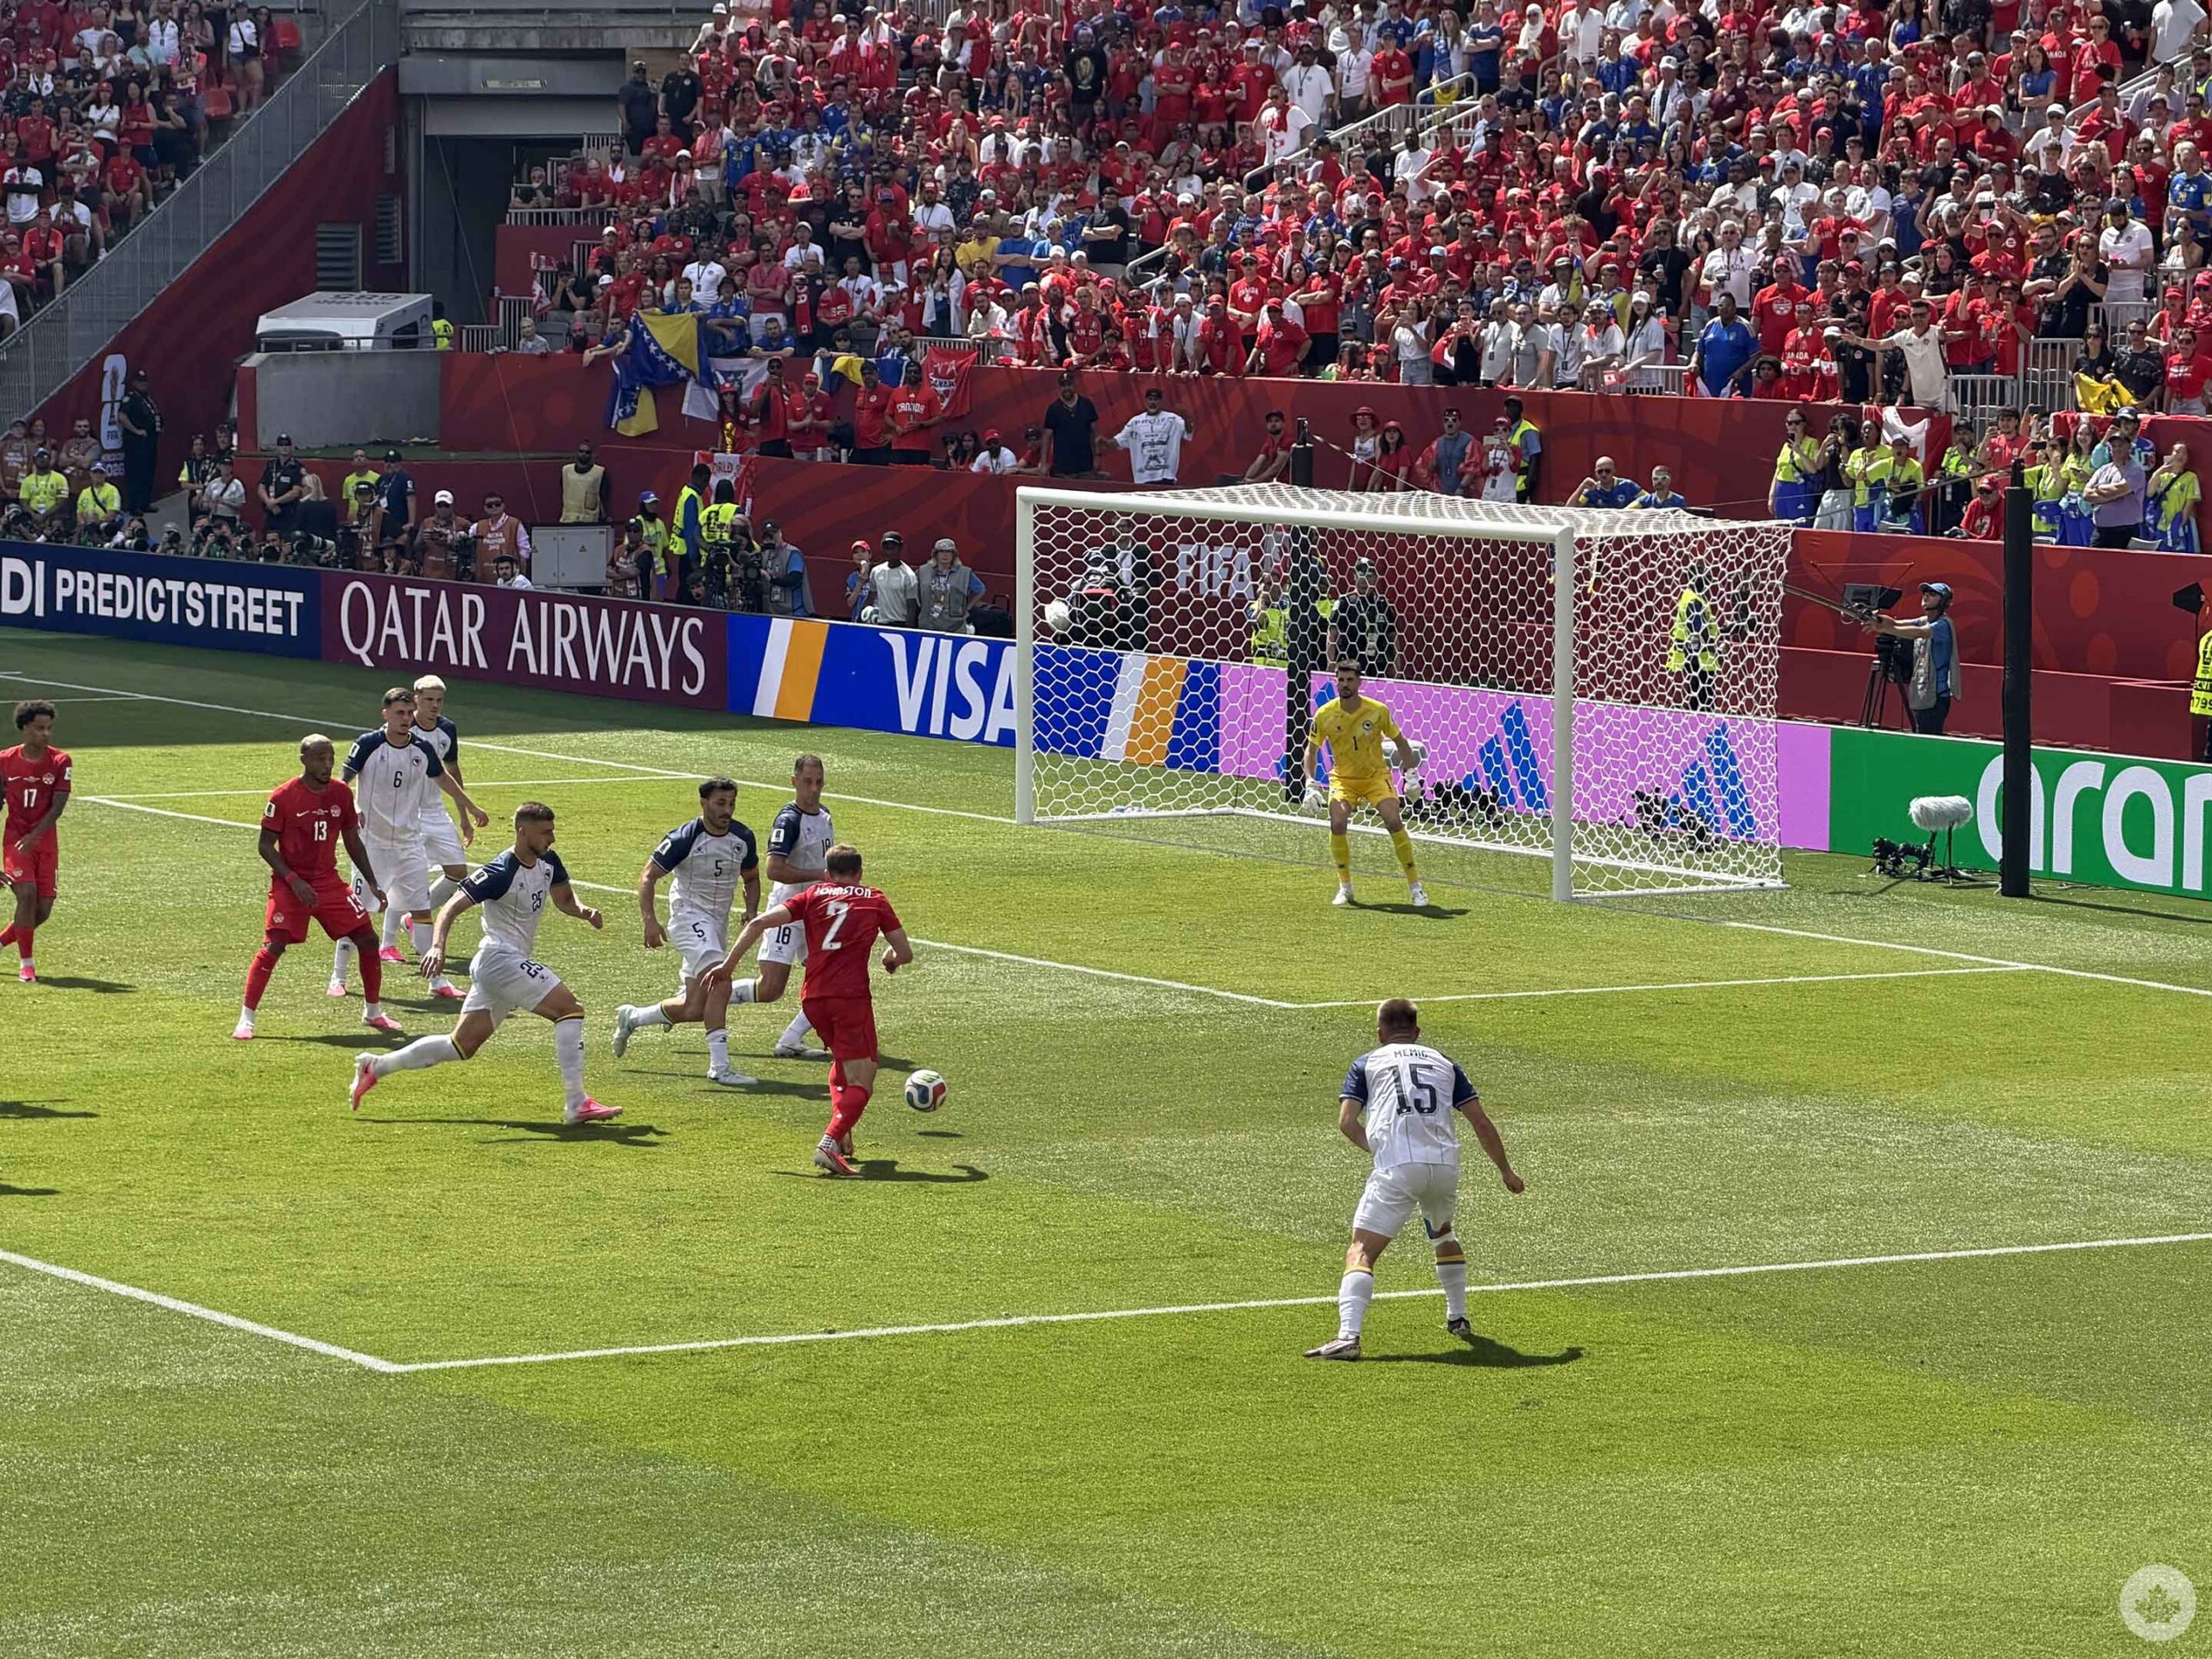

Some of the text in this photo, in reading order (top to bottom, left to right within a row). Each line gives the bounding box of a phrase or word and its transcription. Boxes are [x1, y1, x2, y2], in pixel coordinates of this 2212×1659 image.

[1178, 543, 1255, 596] FIFA
[55, 568, 304, 637] PREDICTSTREET
[340, 580, 706, 696] QATAR AIRWAYS
[879, 632, 1017, 743] VISA
[393, 771, 403, 788] 6
[23, 788, 37, 808] 17
[314, 821, 327, 841] 13
[714, 860, 723, 877] 5
[355, 878, 363, 895] 6
[531, 890, 543, 912] 25
[692, 922, 705, 938] 5
[775, 926, 791, 944] 18
[822, 900, 849, 950] 2
[520, 959, 544, 979] 25
[1380, 1064, 1438, 1116] 15
